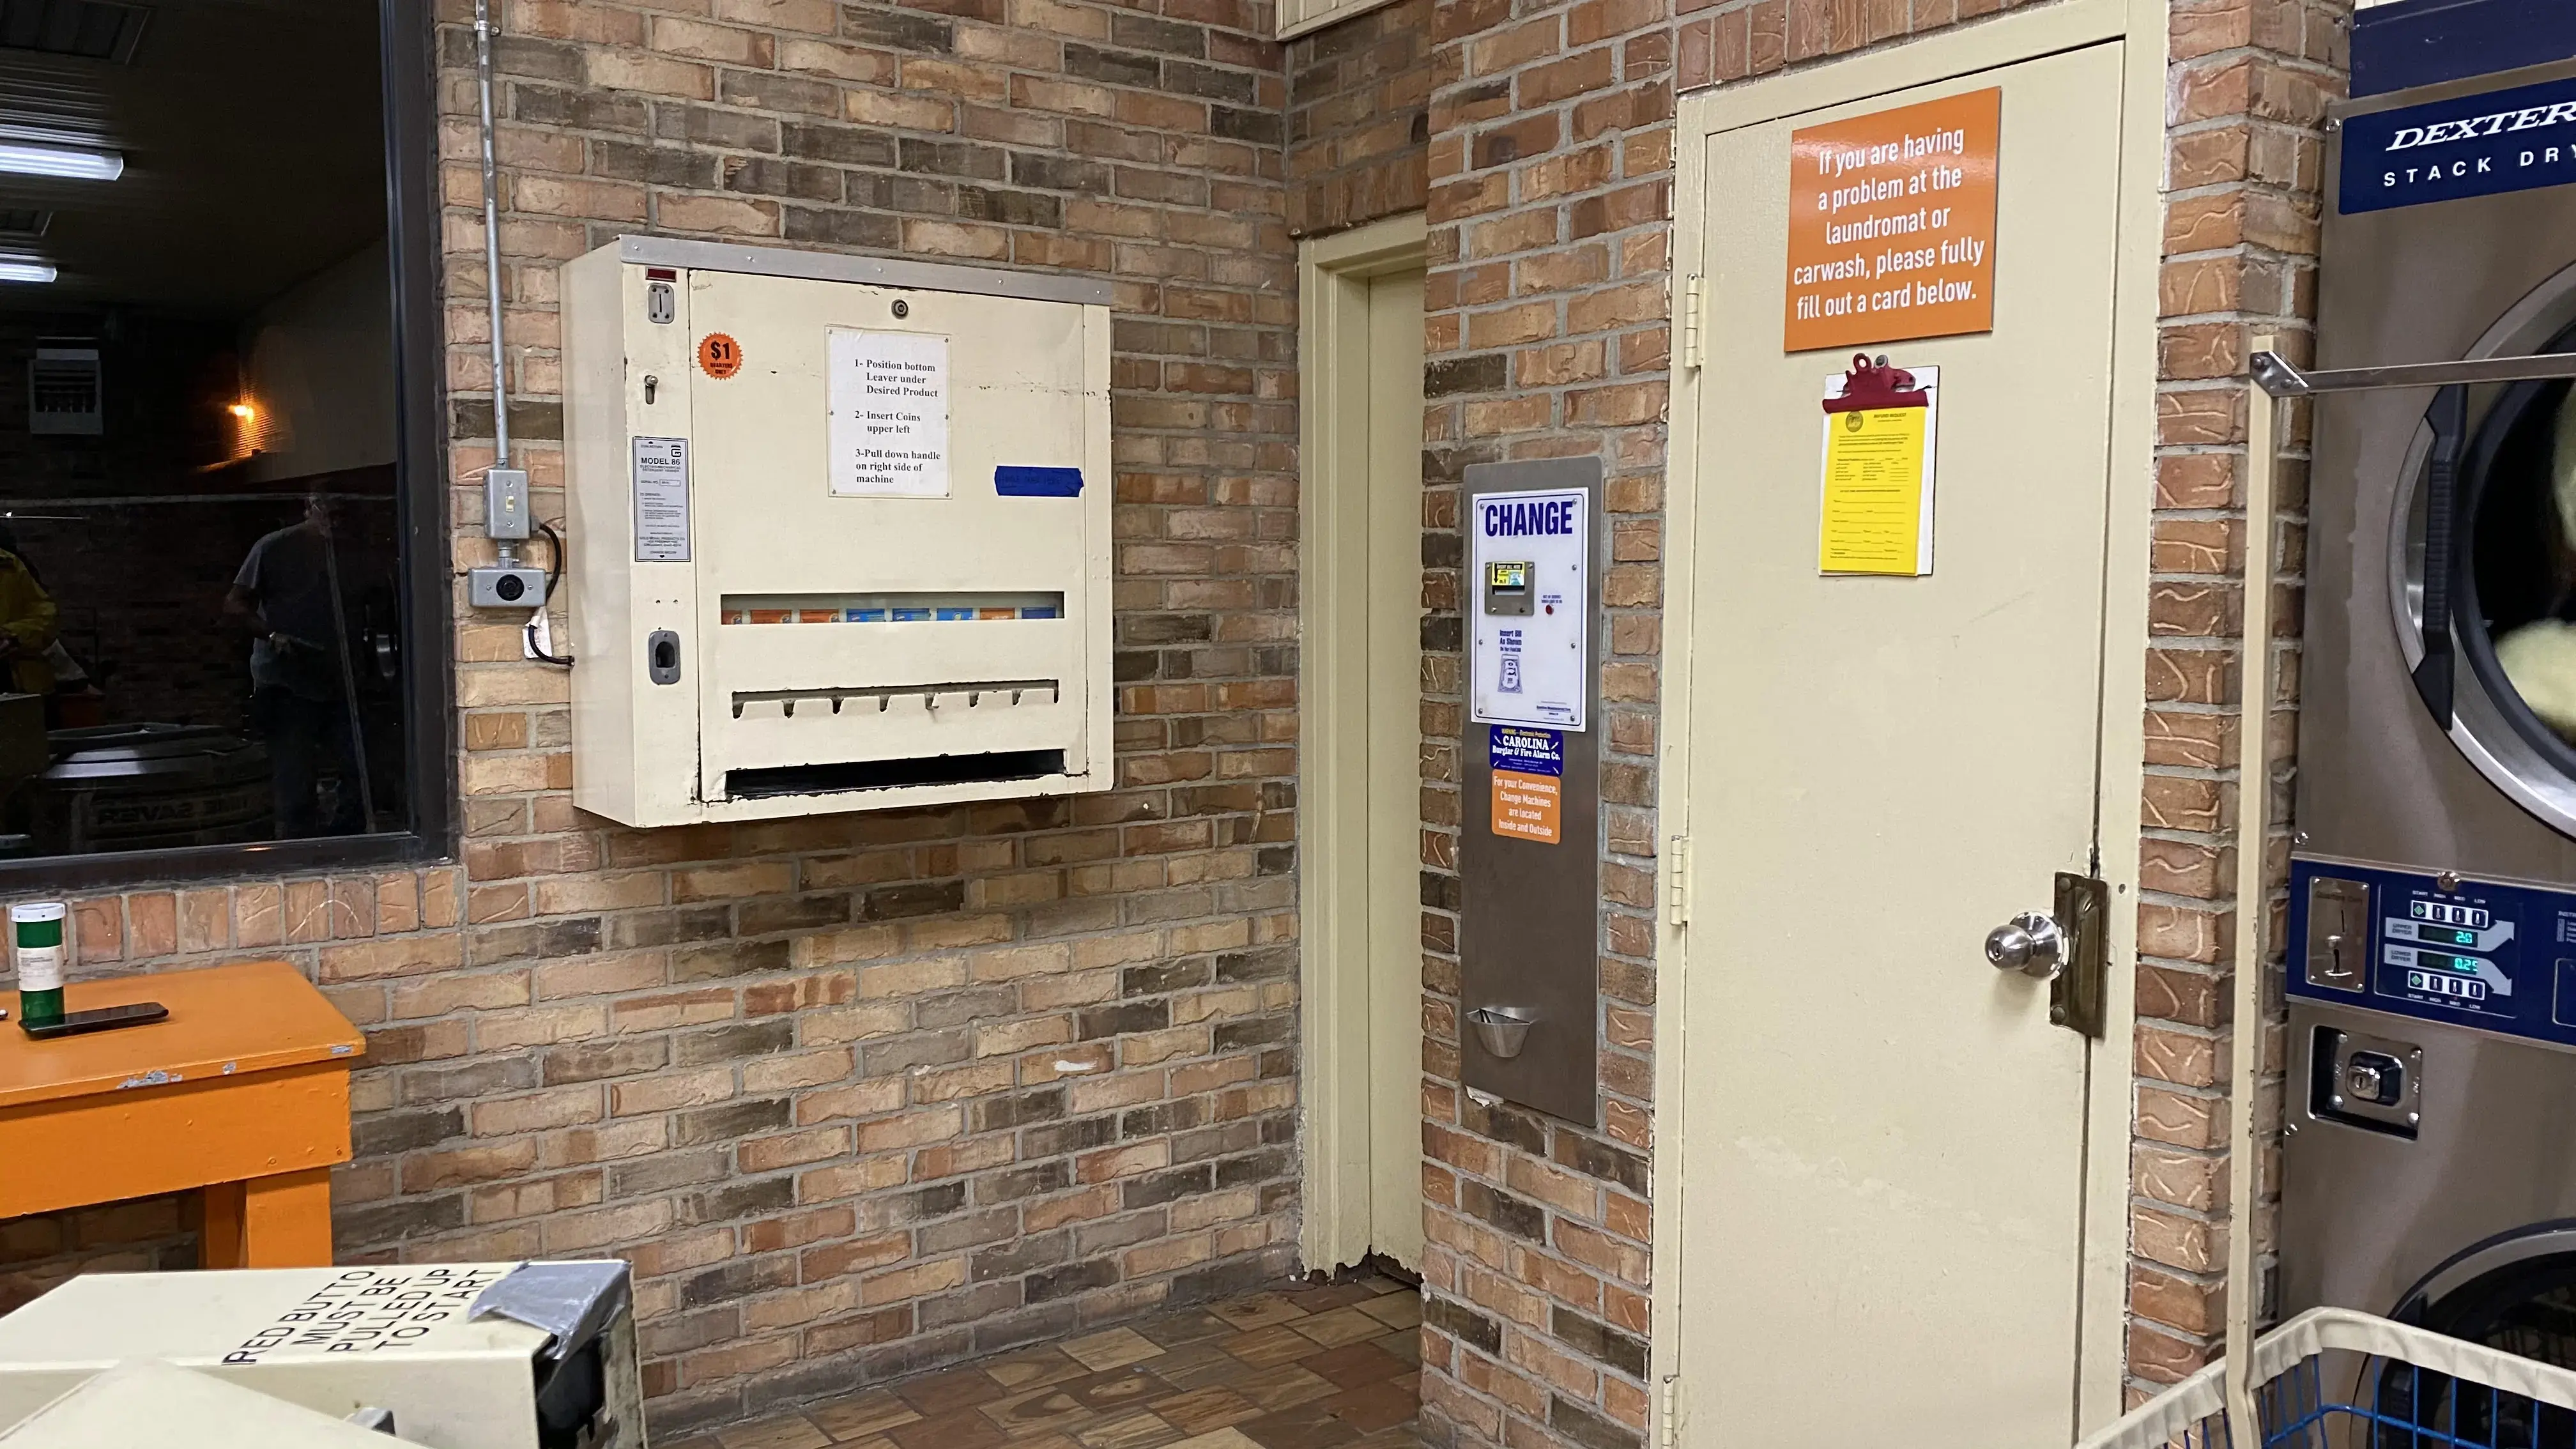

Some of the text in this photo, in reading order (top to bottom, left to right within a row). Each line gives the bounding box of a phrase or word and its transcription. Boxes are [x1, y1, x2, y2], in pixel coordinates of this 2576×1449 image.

[2386, 101, 2576, 151] DEXTER
[1819, 127, 1965, 178] If you are having
[2384, 157, 2492, 187] STACK
[1818, 165, 1961, 214] a problem at the
[1826, 206, 1951, 245] laundromat or
[1794, 236, 1984, 286] carwash, please fully
[1797, 279, 1977, 320] fill out a card below.
[710, 340, 730, 360] $1
[855, 359, 936, 372] 1- Position bottom
[866, 372, 926, 384] Leaver under
[866, 385, 939, 397] Desired Product
[855, 411, 921, 422] 2- Insert Coins
[867, 424, 910, 435] upper left
[855, 448, 940, 460] 3-Pull down handle
[856, 462, 923, 473] on right side of
[856, 474, 894, 484] machine
[1485, 502, 1573, 537] CHANGE
[1503, 735, 1549, 750] CAROLINA
[1492, 745, 1561, 760] Burglar & Fire Alarm Co.
[1494, 776, 1558, 795] For your Convenience,
[1500, 791, 1551, 808] Change Machines
[1508, 808, 1542, 820] are located
[1498, 818, 1552, 837] Inside and Outside
[222, 1269, 377, 1366] RED BUTTO
[290, 1277, 413, 1345] MUST BE
[324, 1269, 458, 1353] PULLED UP
[374, 1269, 503, 1351] TO START
